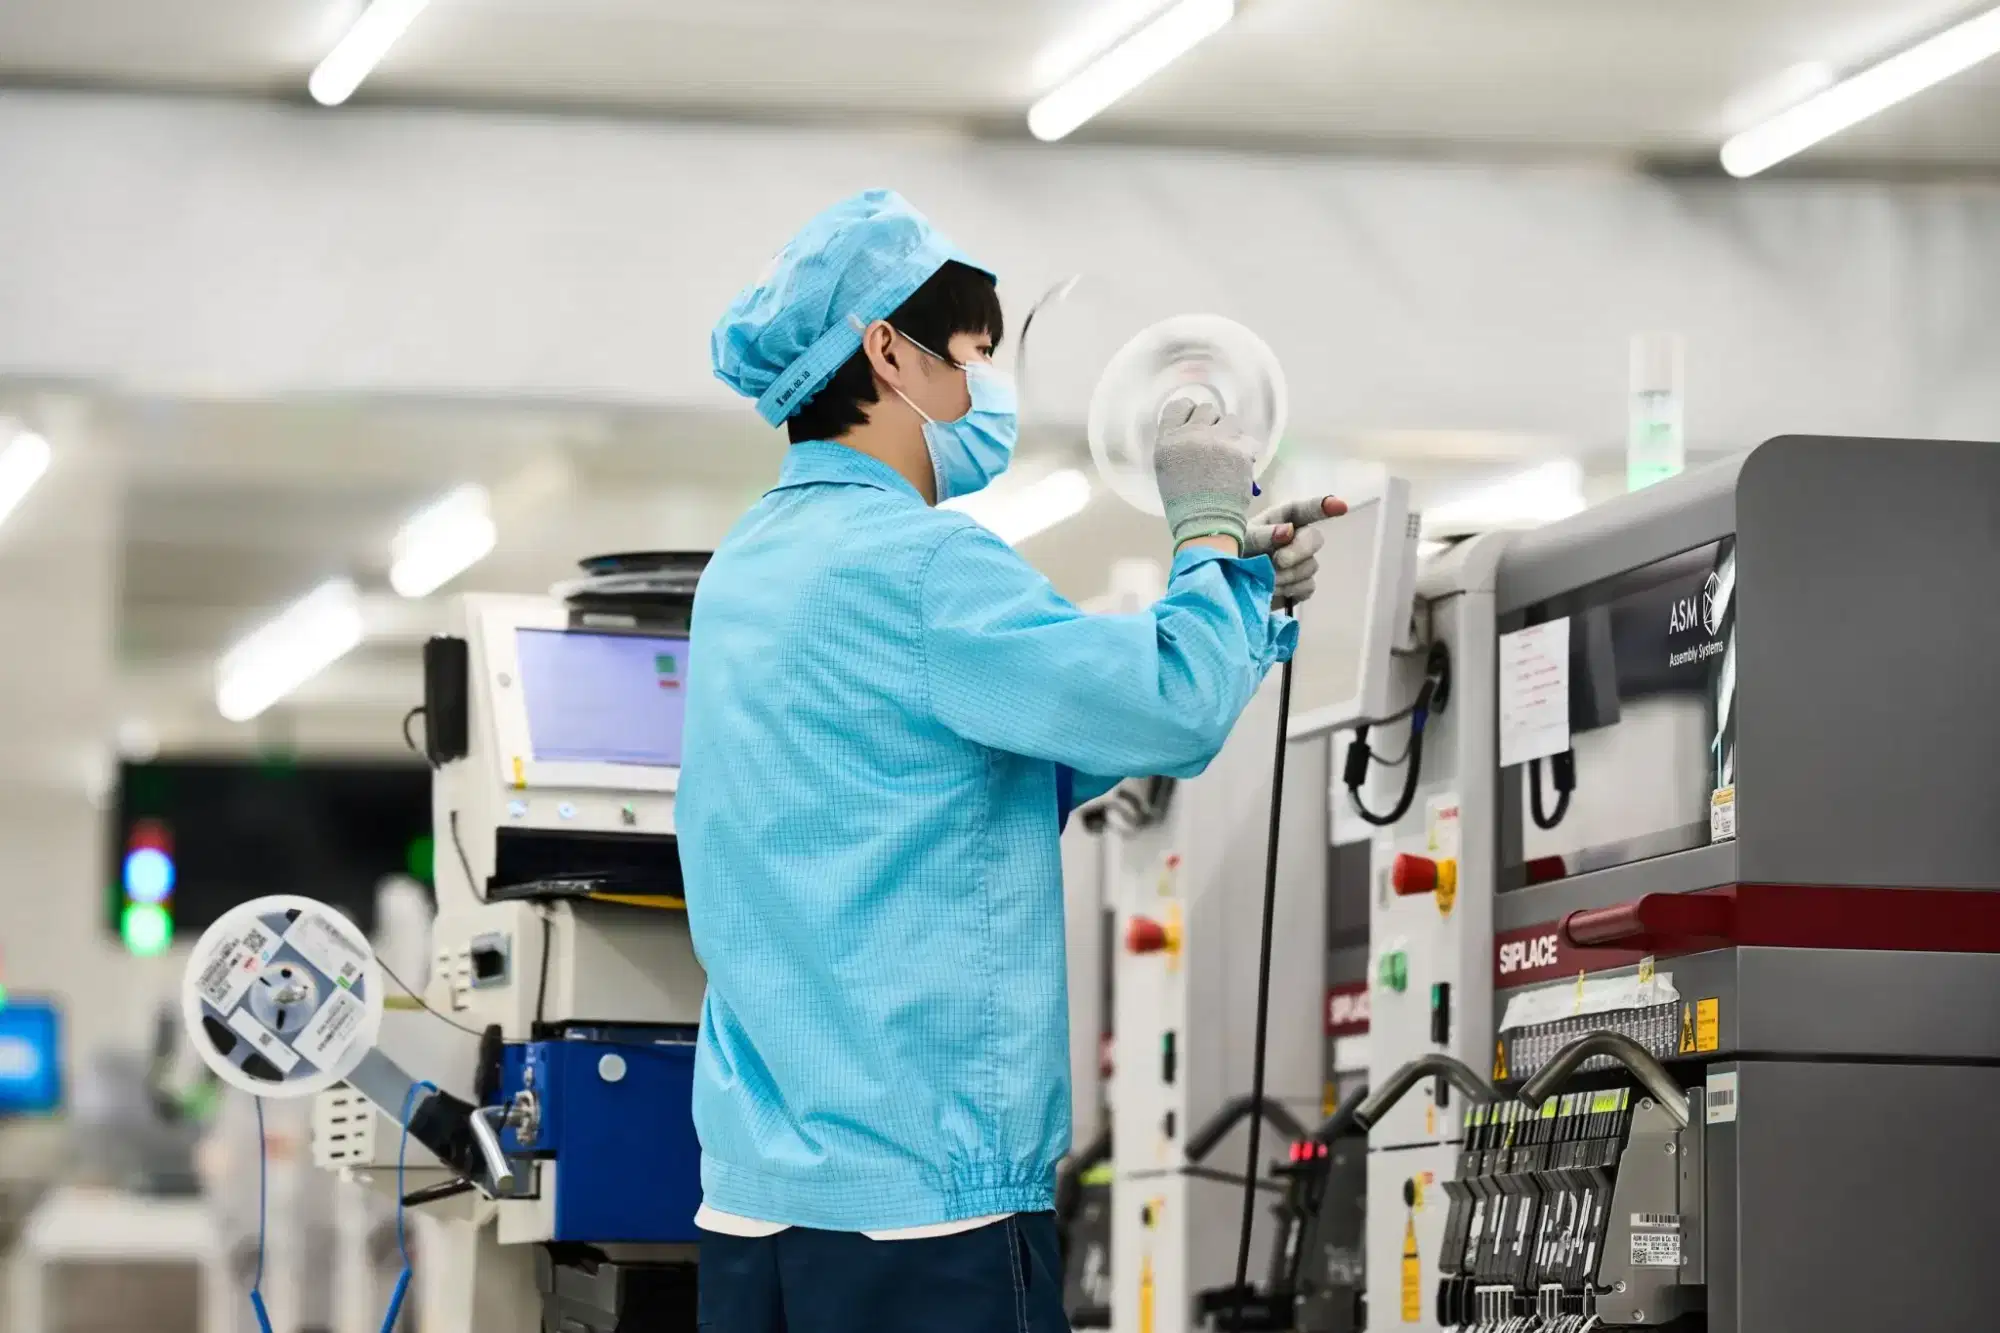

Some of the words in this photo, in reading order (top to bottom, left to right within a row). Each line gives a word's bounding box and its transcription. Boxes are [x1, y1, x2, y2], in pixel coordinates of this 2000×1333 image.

[1669, 596, 1698, 635] ASM
[1669, 645, 1698, 668] Assembly
[1698, 641, 1723, 660] Systems
[1499, 934, 1558, 974] SIPLACE
